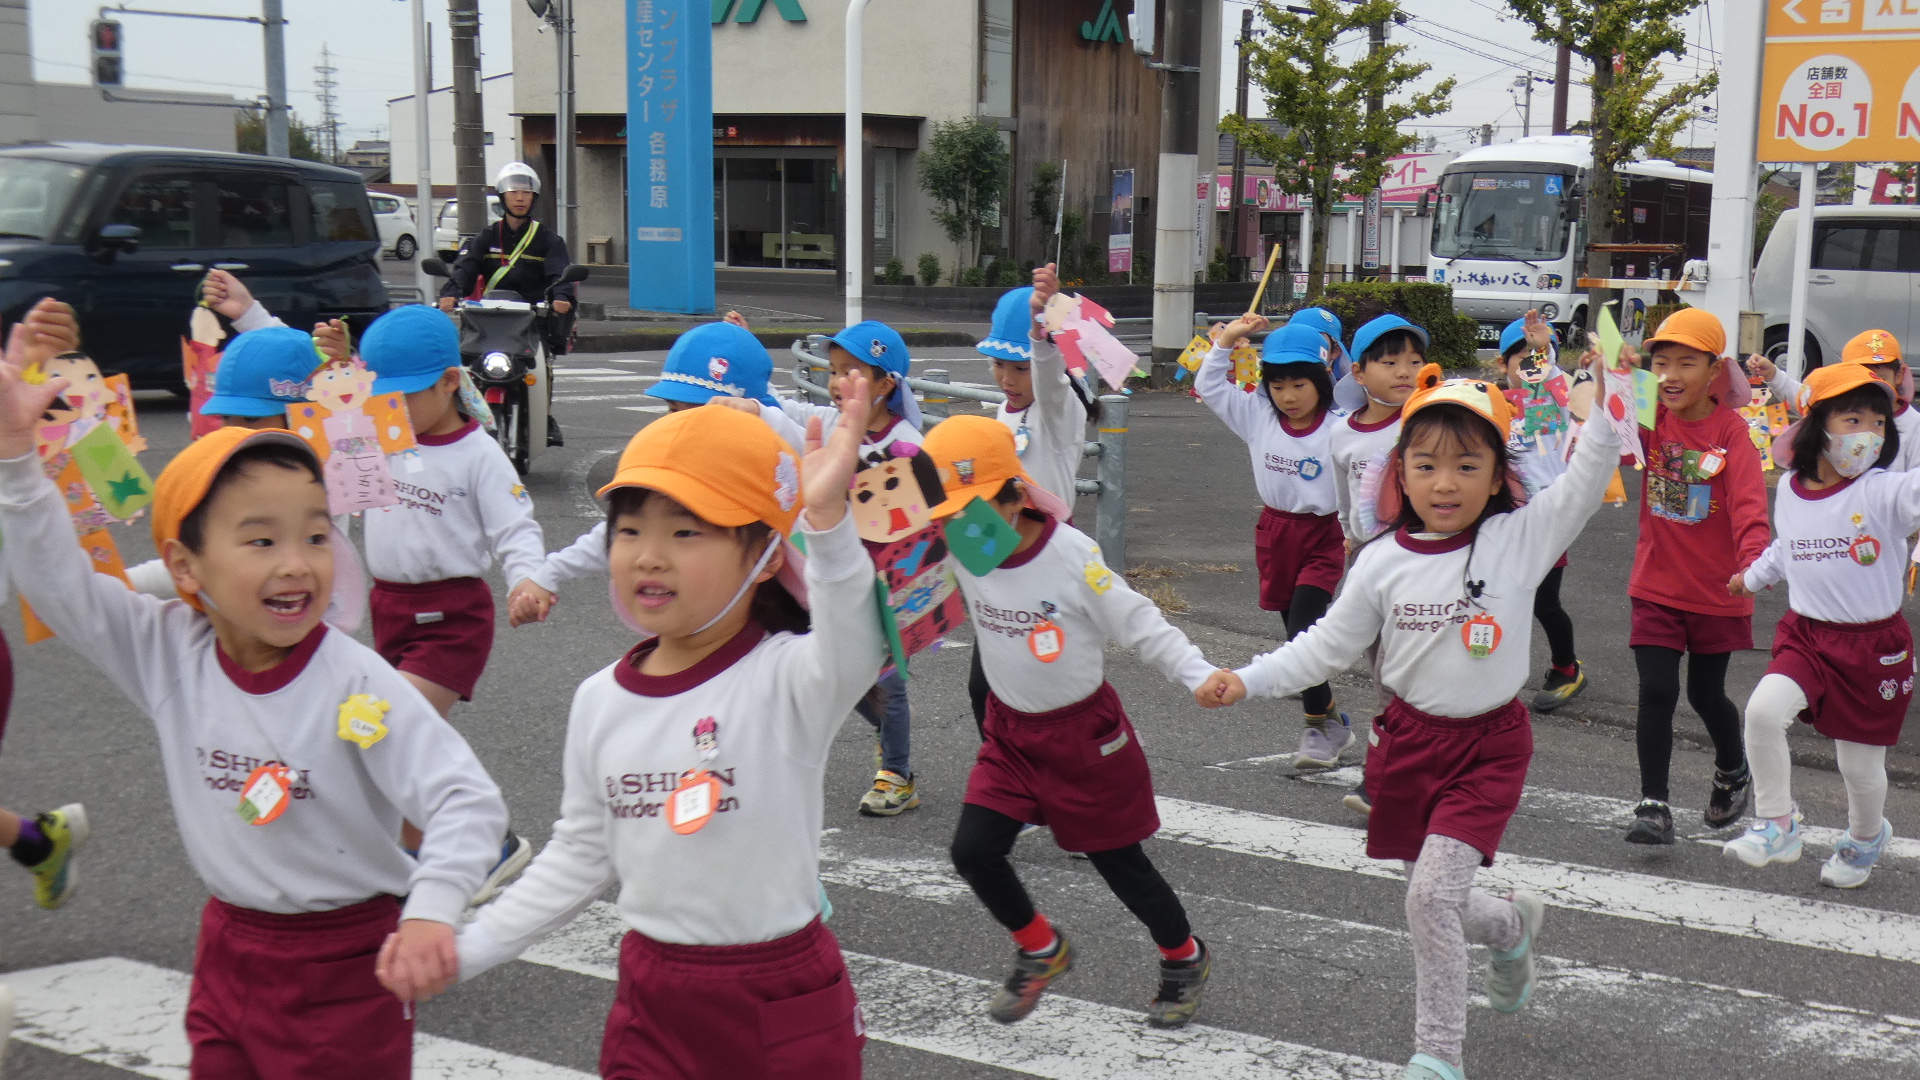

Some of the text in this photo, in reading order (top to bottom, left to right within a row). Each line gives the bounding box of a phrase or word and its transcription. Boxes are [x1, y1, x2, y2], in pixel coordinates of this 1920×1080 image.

[1806, 66, 1848, 81] 店舗数
[1807, 82, 1842, 99] 全国
[1777, 102, 1869, 138] No.1
[649, 131, 669, 209] 各務原
[1451, 270, 1531, 287] ふれあいバス
[1271, 454, 1300, 469] SHIO
[1797, 536, 1851, 550] SHION
